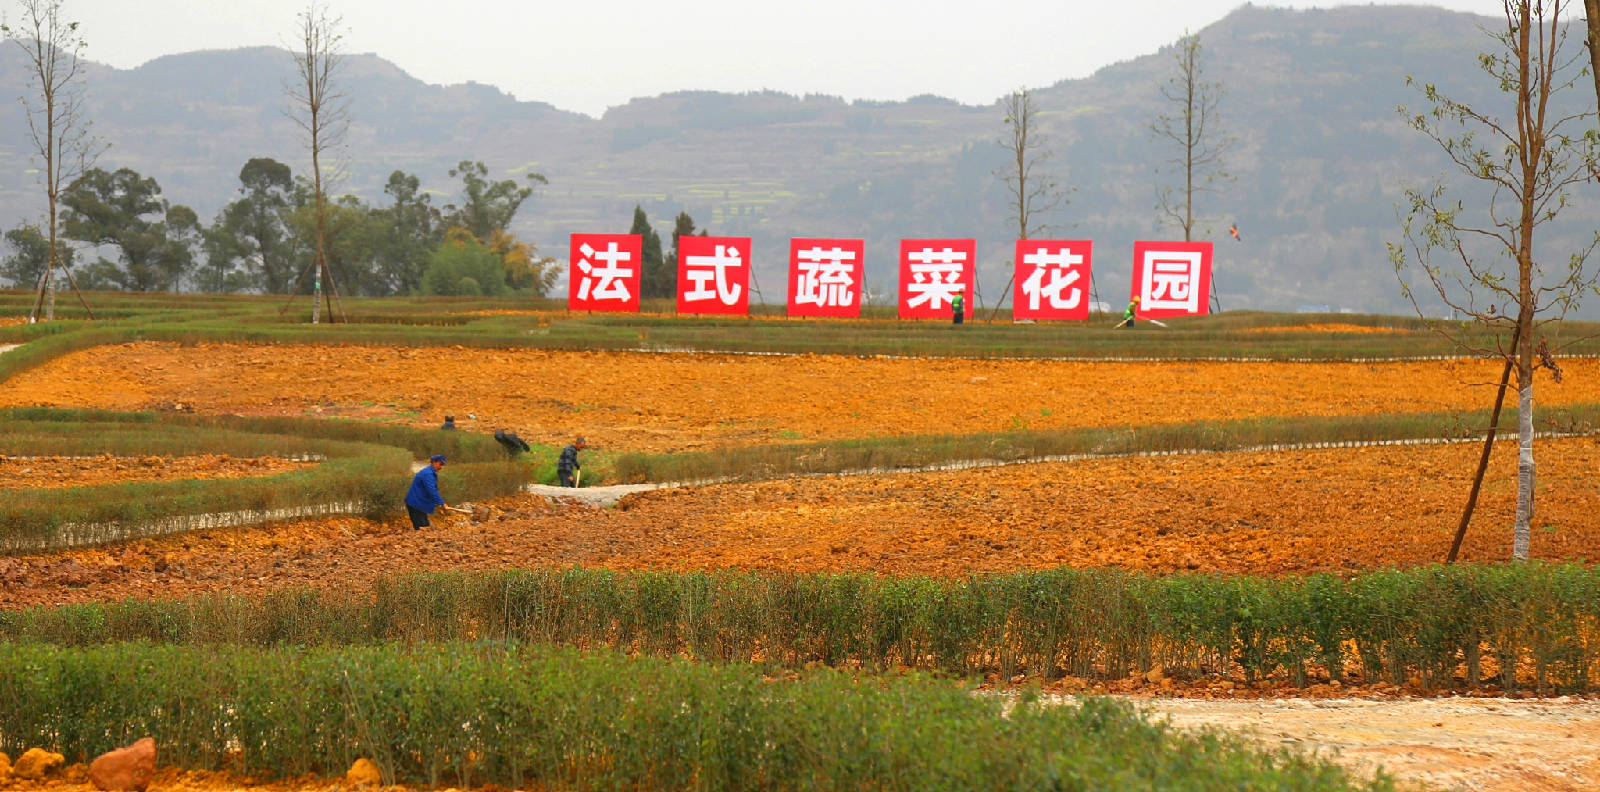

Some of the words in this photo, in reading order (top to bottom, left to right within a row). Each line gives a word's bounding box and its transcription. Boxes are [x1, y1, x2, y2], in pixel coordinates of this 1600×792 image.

[577, 242, 1202, 313] 法式蔬菜花园
